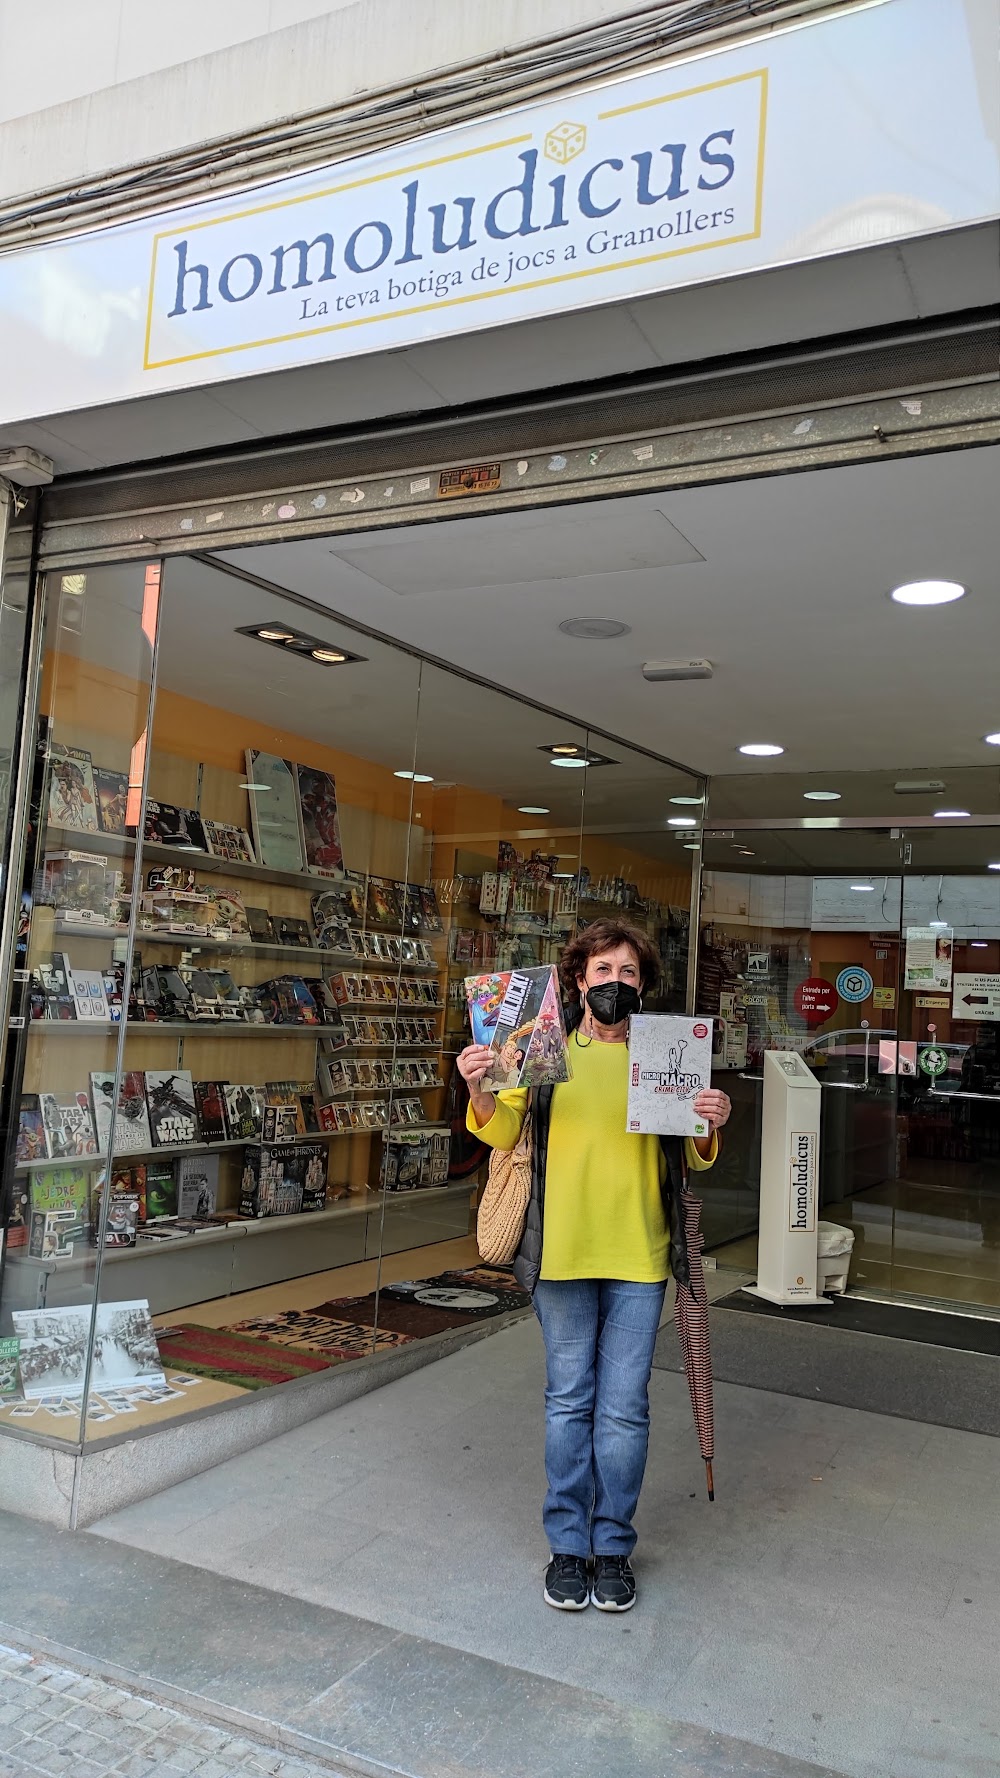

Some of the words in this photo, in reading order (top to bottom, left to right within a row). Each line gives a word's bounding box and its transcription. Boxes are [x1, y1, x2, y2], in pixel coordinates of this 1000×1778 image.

[167, 129, 735, 318] homoludicus
[299, 298, 328, 320] La
[336, 288, 380, 312] teva
[387, 271, 463, 299] botiga
[470, 258, 499, 281] de
[504, 250, 556, 283] jocs
[564, 245, 577, 262] a
[586, 207, 735, 254] Granollers
[499, 972, 530, 1027] UNLOCK!
[642, 1072, 660, 1080] MICRO
[660, 1073, 700, 1087] MACRO
[60, 1109, 83, 1118] TAR
[60, 1118, 83, 1127] ARS
[156, 1116, 194, 1131] STAR
[157, 1128, 194, 1143] WARS
[294, 1145, 321, 1157] THRONES
[791, 1135, 809, 1228] homoludicus
